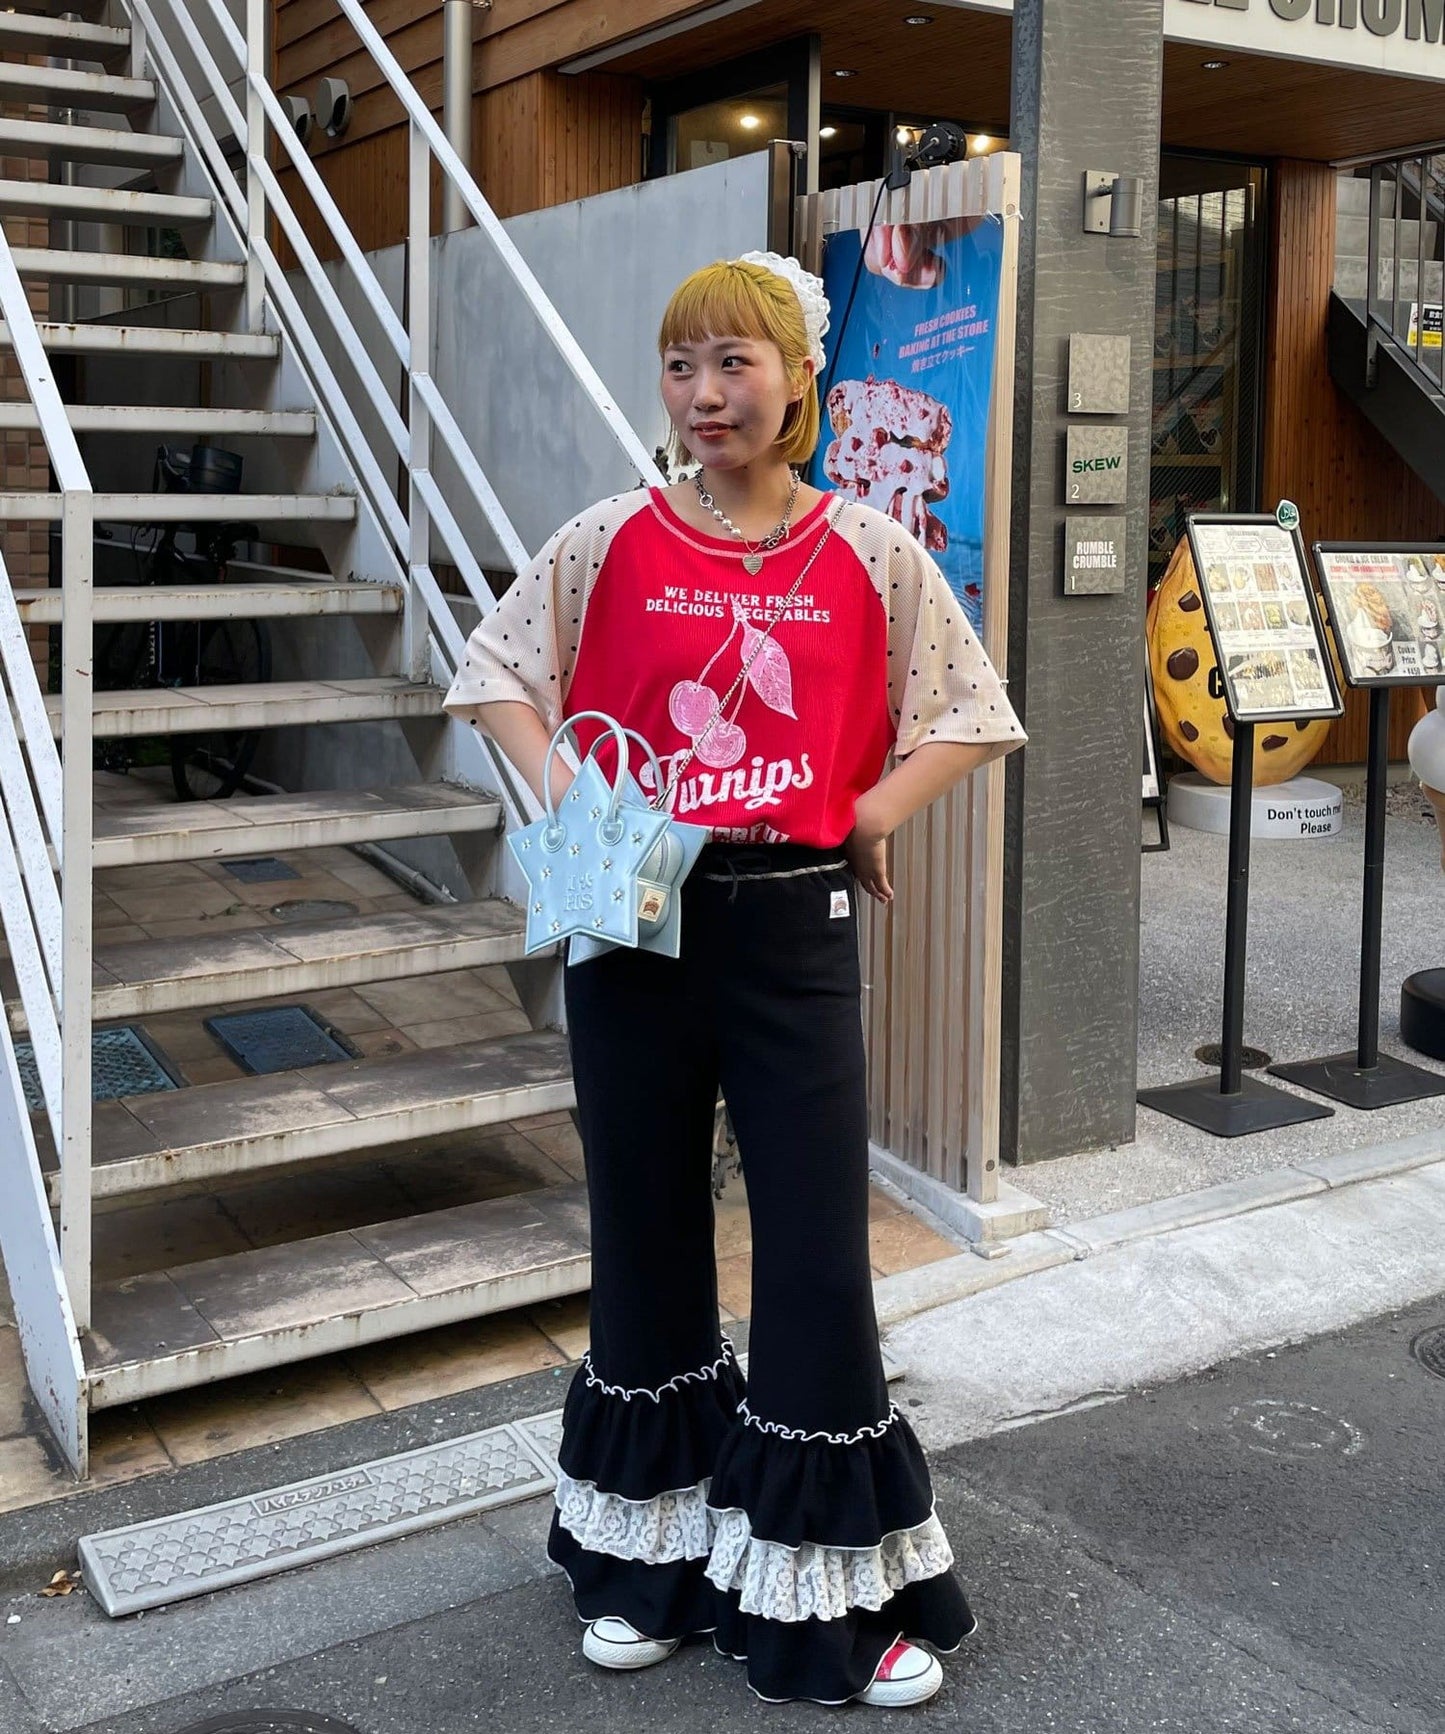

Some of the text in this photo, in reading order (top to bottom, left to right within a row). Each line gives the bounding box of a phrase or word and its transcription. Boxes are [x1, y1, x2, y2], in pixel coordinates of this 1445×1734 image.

[914, 304, 976, 337] FRESH COOKIES
[898, 319, 989, 359] BAKING AT THE STORE
[911, 345, 975, 373] 焼き立てクッキー
[1073, 392, 1082, 408] 3
[1072, 456, 1121, 473] SKEW
[1071, 484, 1080, 499] 2
[1076, 541, 1114, 555] RUMBLE
[1073, 554, 1117, 569] CRUMBLE
[1070, 575, 1076, 590] 1
[664, 585, 814, 608] WE DELIVER FRESH
[645, 598, 724, 618] DELICIOUS
[639, 748, 814, 814] Turnips
[1267, 807, 1302, 820] Don't
[1304, 804, 1332, 818] touch
[1300, 822, 1332, 834] Please
